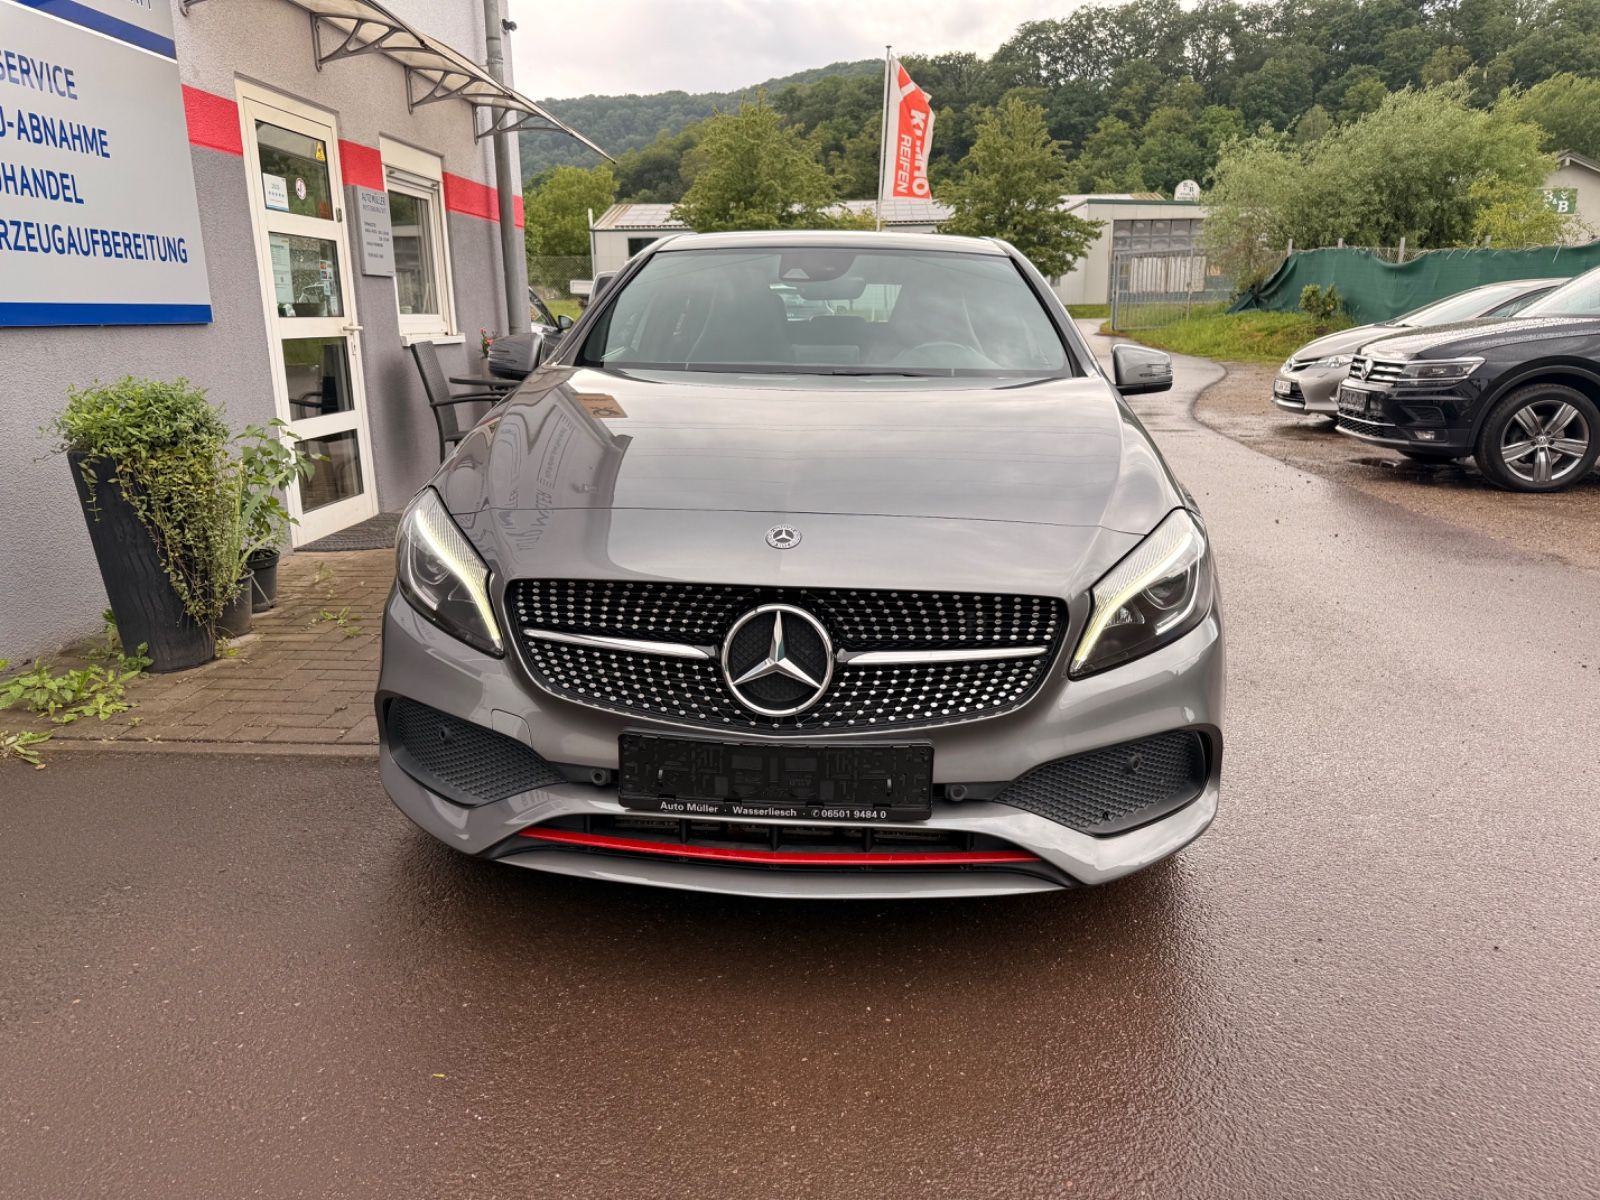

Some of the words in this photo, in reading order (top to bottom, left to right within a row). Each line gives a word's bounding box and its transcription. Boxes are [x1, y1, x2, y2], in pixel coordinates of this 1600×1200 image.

[0, 162, 84, 205] HANDEL
[896, 134, 912, 193] REIFEN
[660, 801, 684, 812] Auto
[686, 802, 719, 814] Müller
[732, 805, 798, 817] Wasserliesch
[821, 809, 851, 820] 06501
[854, 810, 878, 819] 9484
[880, 810, 888, 819] 0
